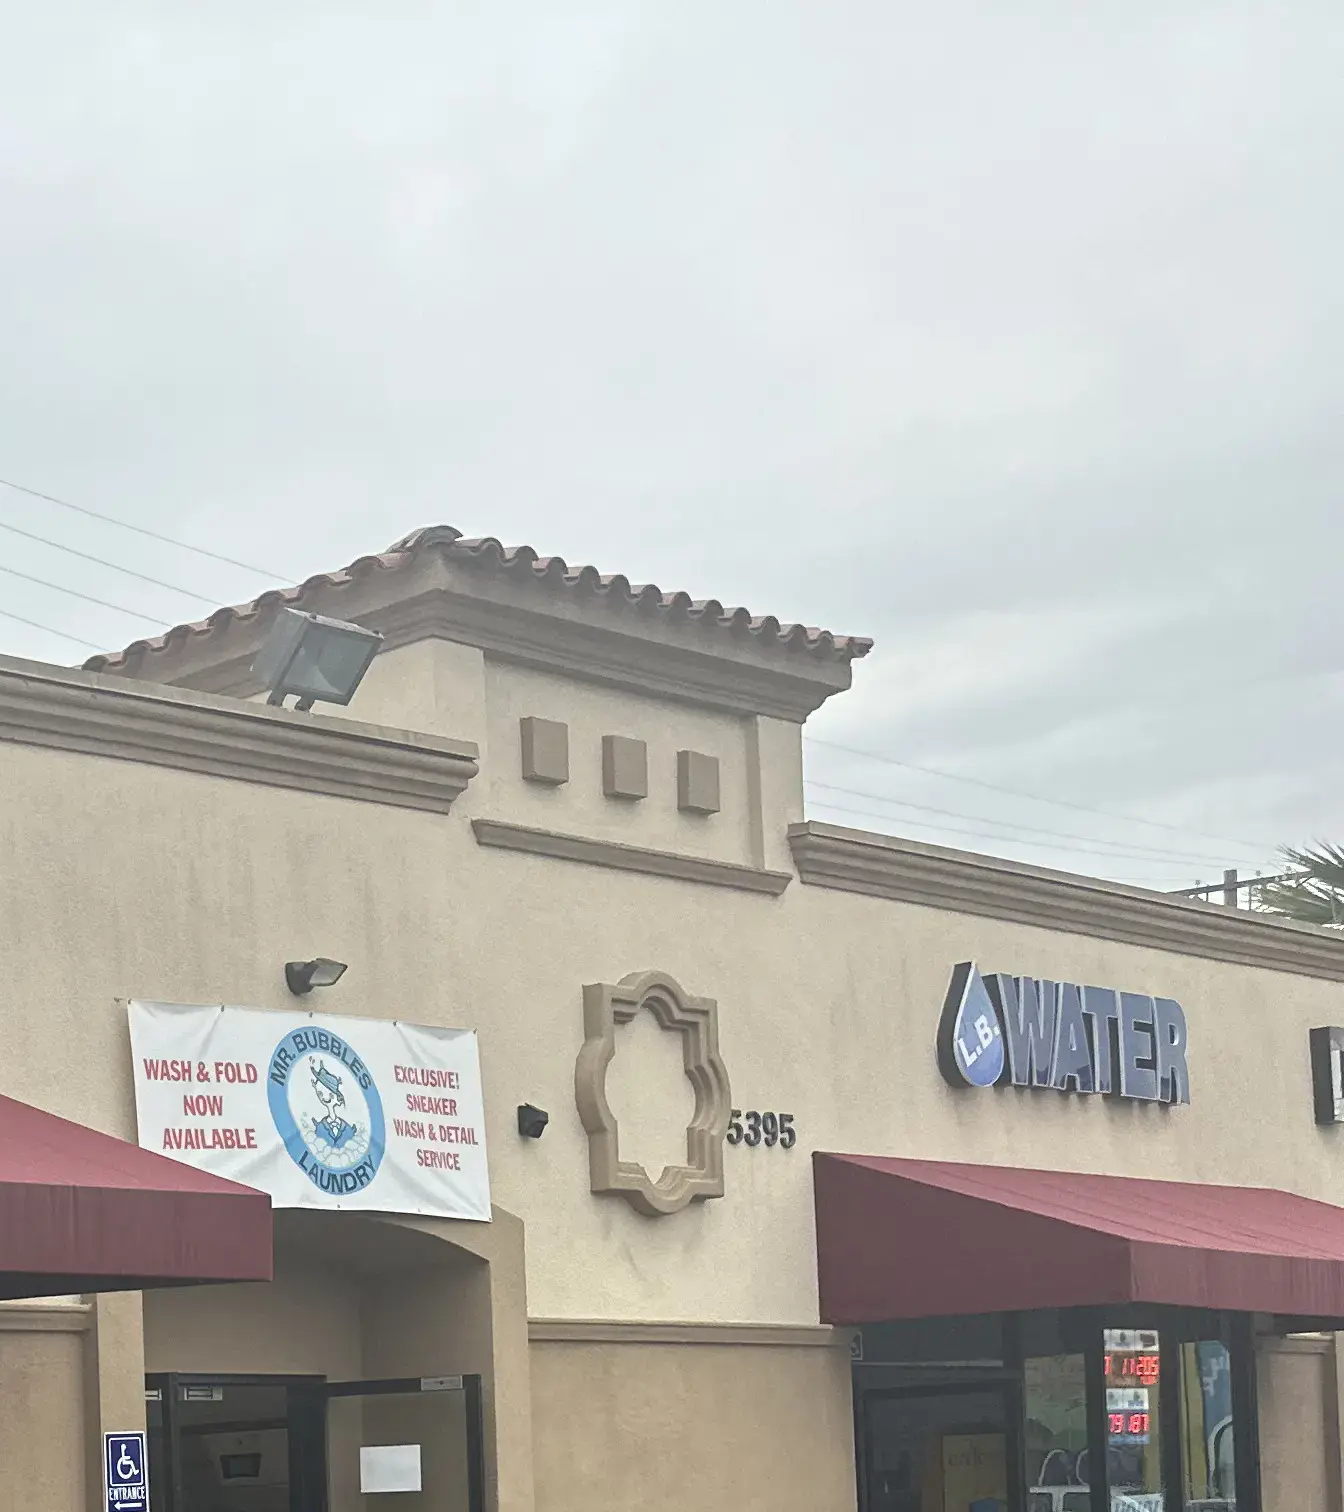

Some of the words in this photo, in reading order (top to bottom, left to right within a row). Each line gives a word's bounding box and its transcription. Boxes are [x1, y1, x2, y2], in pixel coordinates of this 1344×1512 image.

[958, 1014, 1000, 1067] L.B.
[983, 973, 1191, 1106] WATER
[143, 1058, 193, 1083] WASH
[197, 1062, 210, 1083] &
[214, 1062, 258, 1084] FOLD
[269, 1048, 296, 1087] MR.
[292, 1031, 372, 1091] BUBBLES
[394, 1065, 460, 1090] EXCLUSIVE!
[183, 1094, 223, 1117] NOW
[406, 1093, 458, 1117] SNEAKER
[162, 1127, 258, 1150] AVAILABLE
[393, 1119, 426, 1140] WASH
[428, 1126, 437, 1141] &
[439, 1127, 479, 1146] DETAIL
[726, 1108, 796, 1149] 5395
[298, 1150, 377, 1194] LAUNDRY
[416, 1149, 461, 1171] SERVICE
[108, 1486, 145, 1500] ENTRANCE
